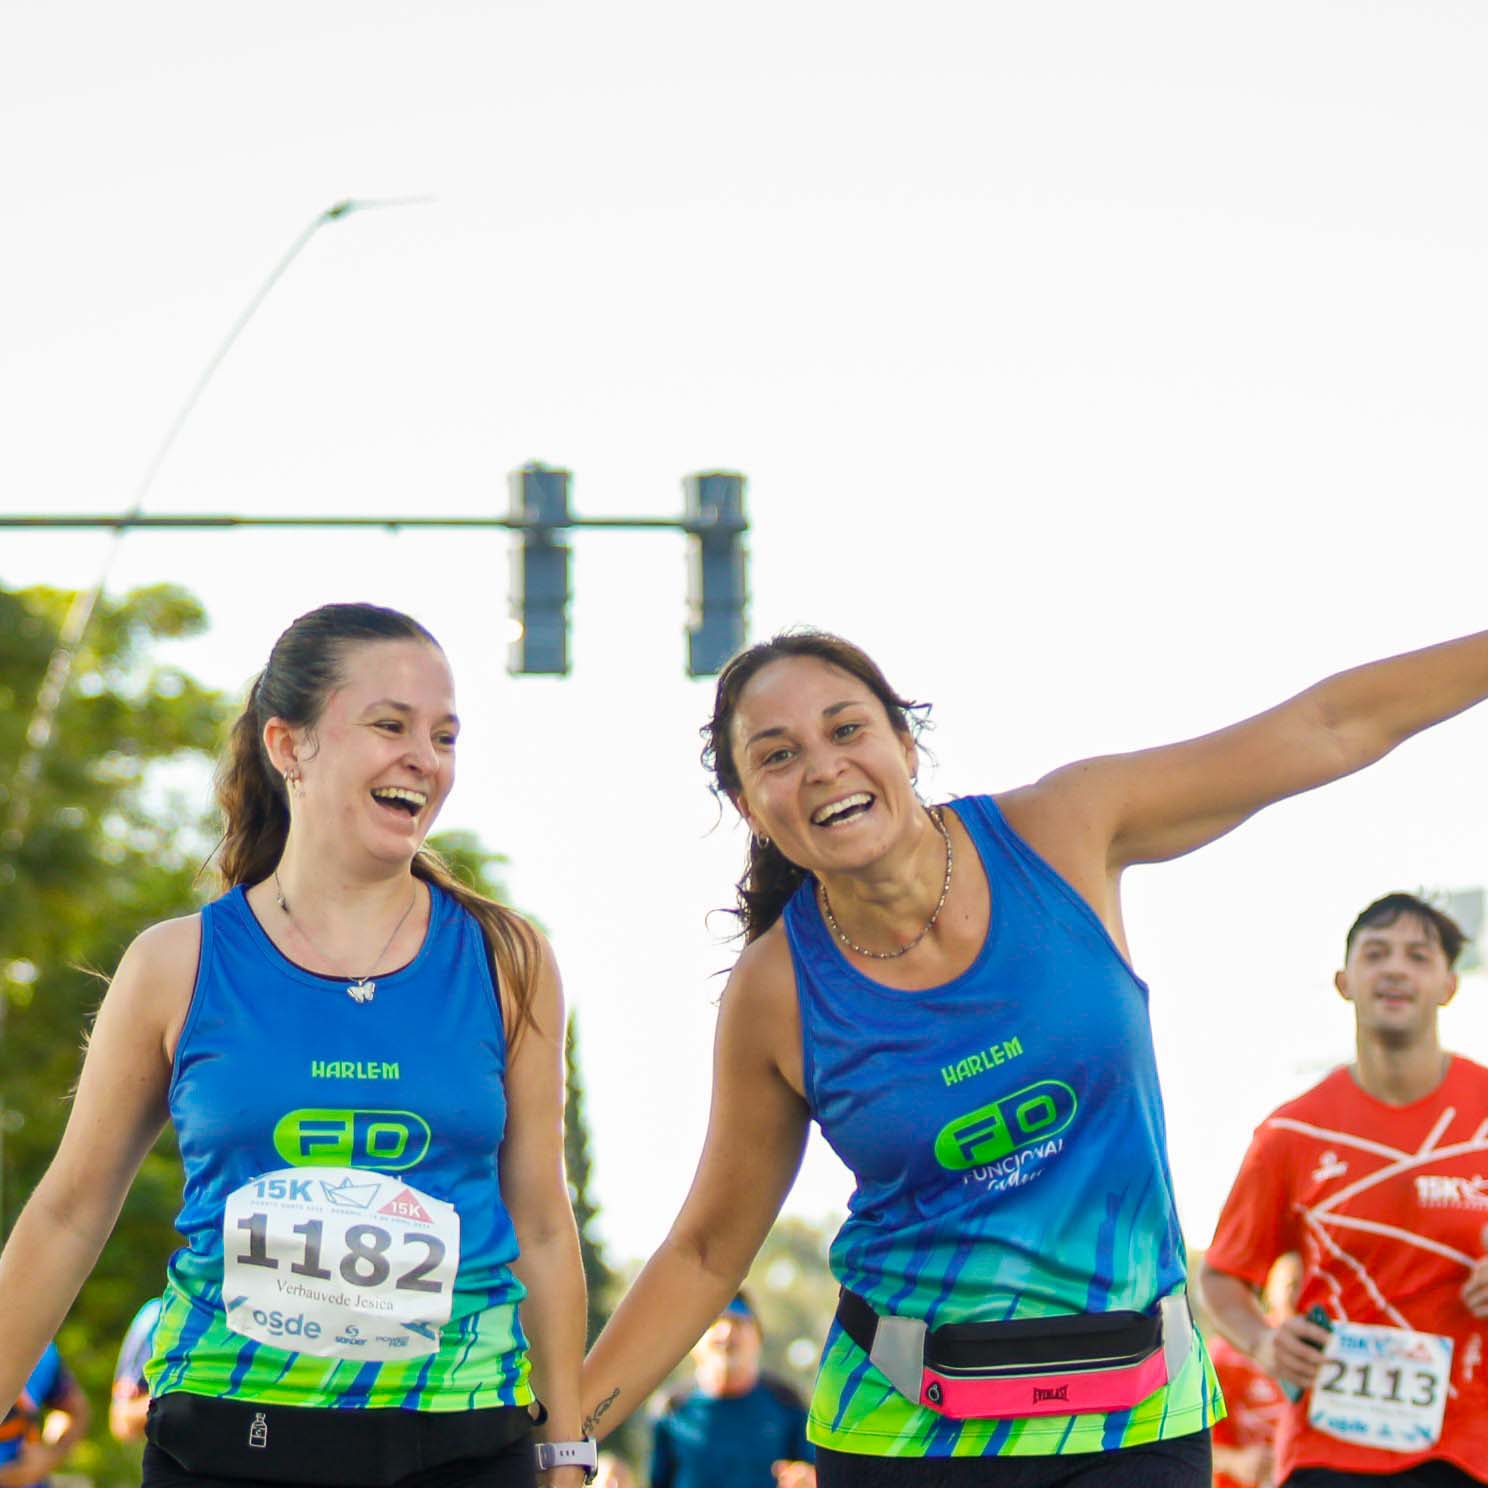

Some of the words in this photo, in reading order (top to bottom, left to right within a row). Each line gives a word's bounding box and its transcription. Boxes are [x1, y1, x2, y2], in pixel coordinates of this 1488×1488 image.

[311, 1060, 400, 1080] HARLEM
[940, 1035, 1024, 1087] HARLEM
[254, 1179, 313, 1202] 15K
[391, 1201, 422, 1219] 15K
[236, 1212, 446, 1293] 1182
[252, 1309, 322, 1339] osde
[1321, 1359, 1439, 1408] 2113
